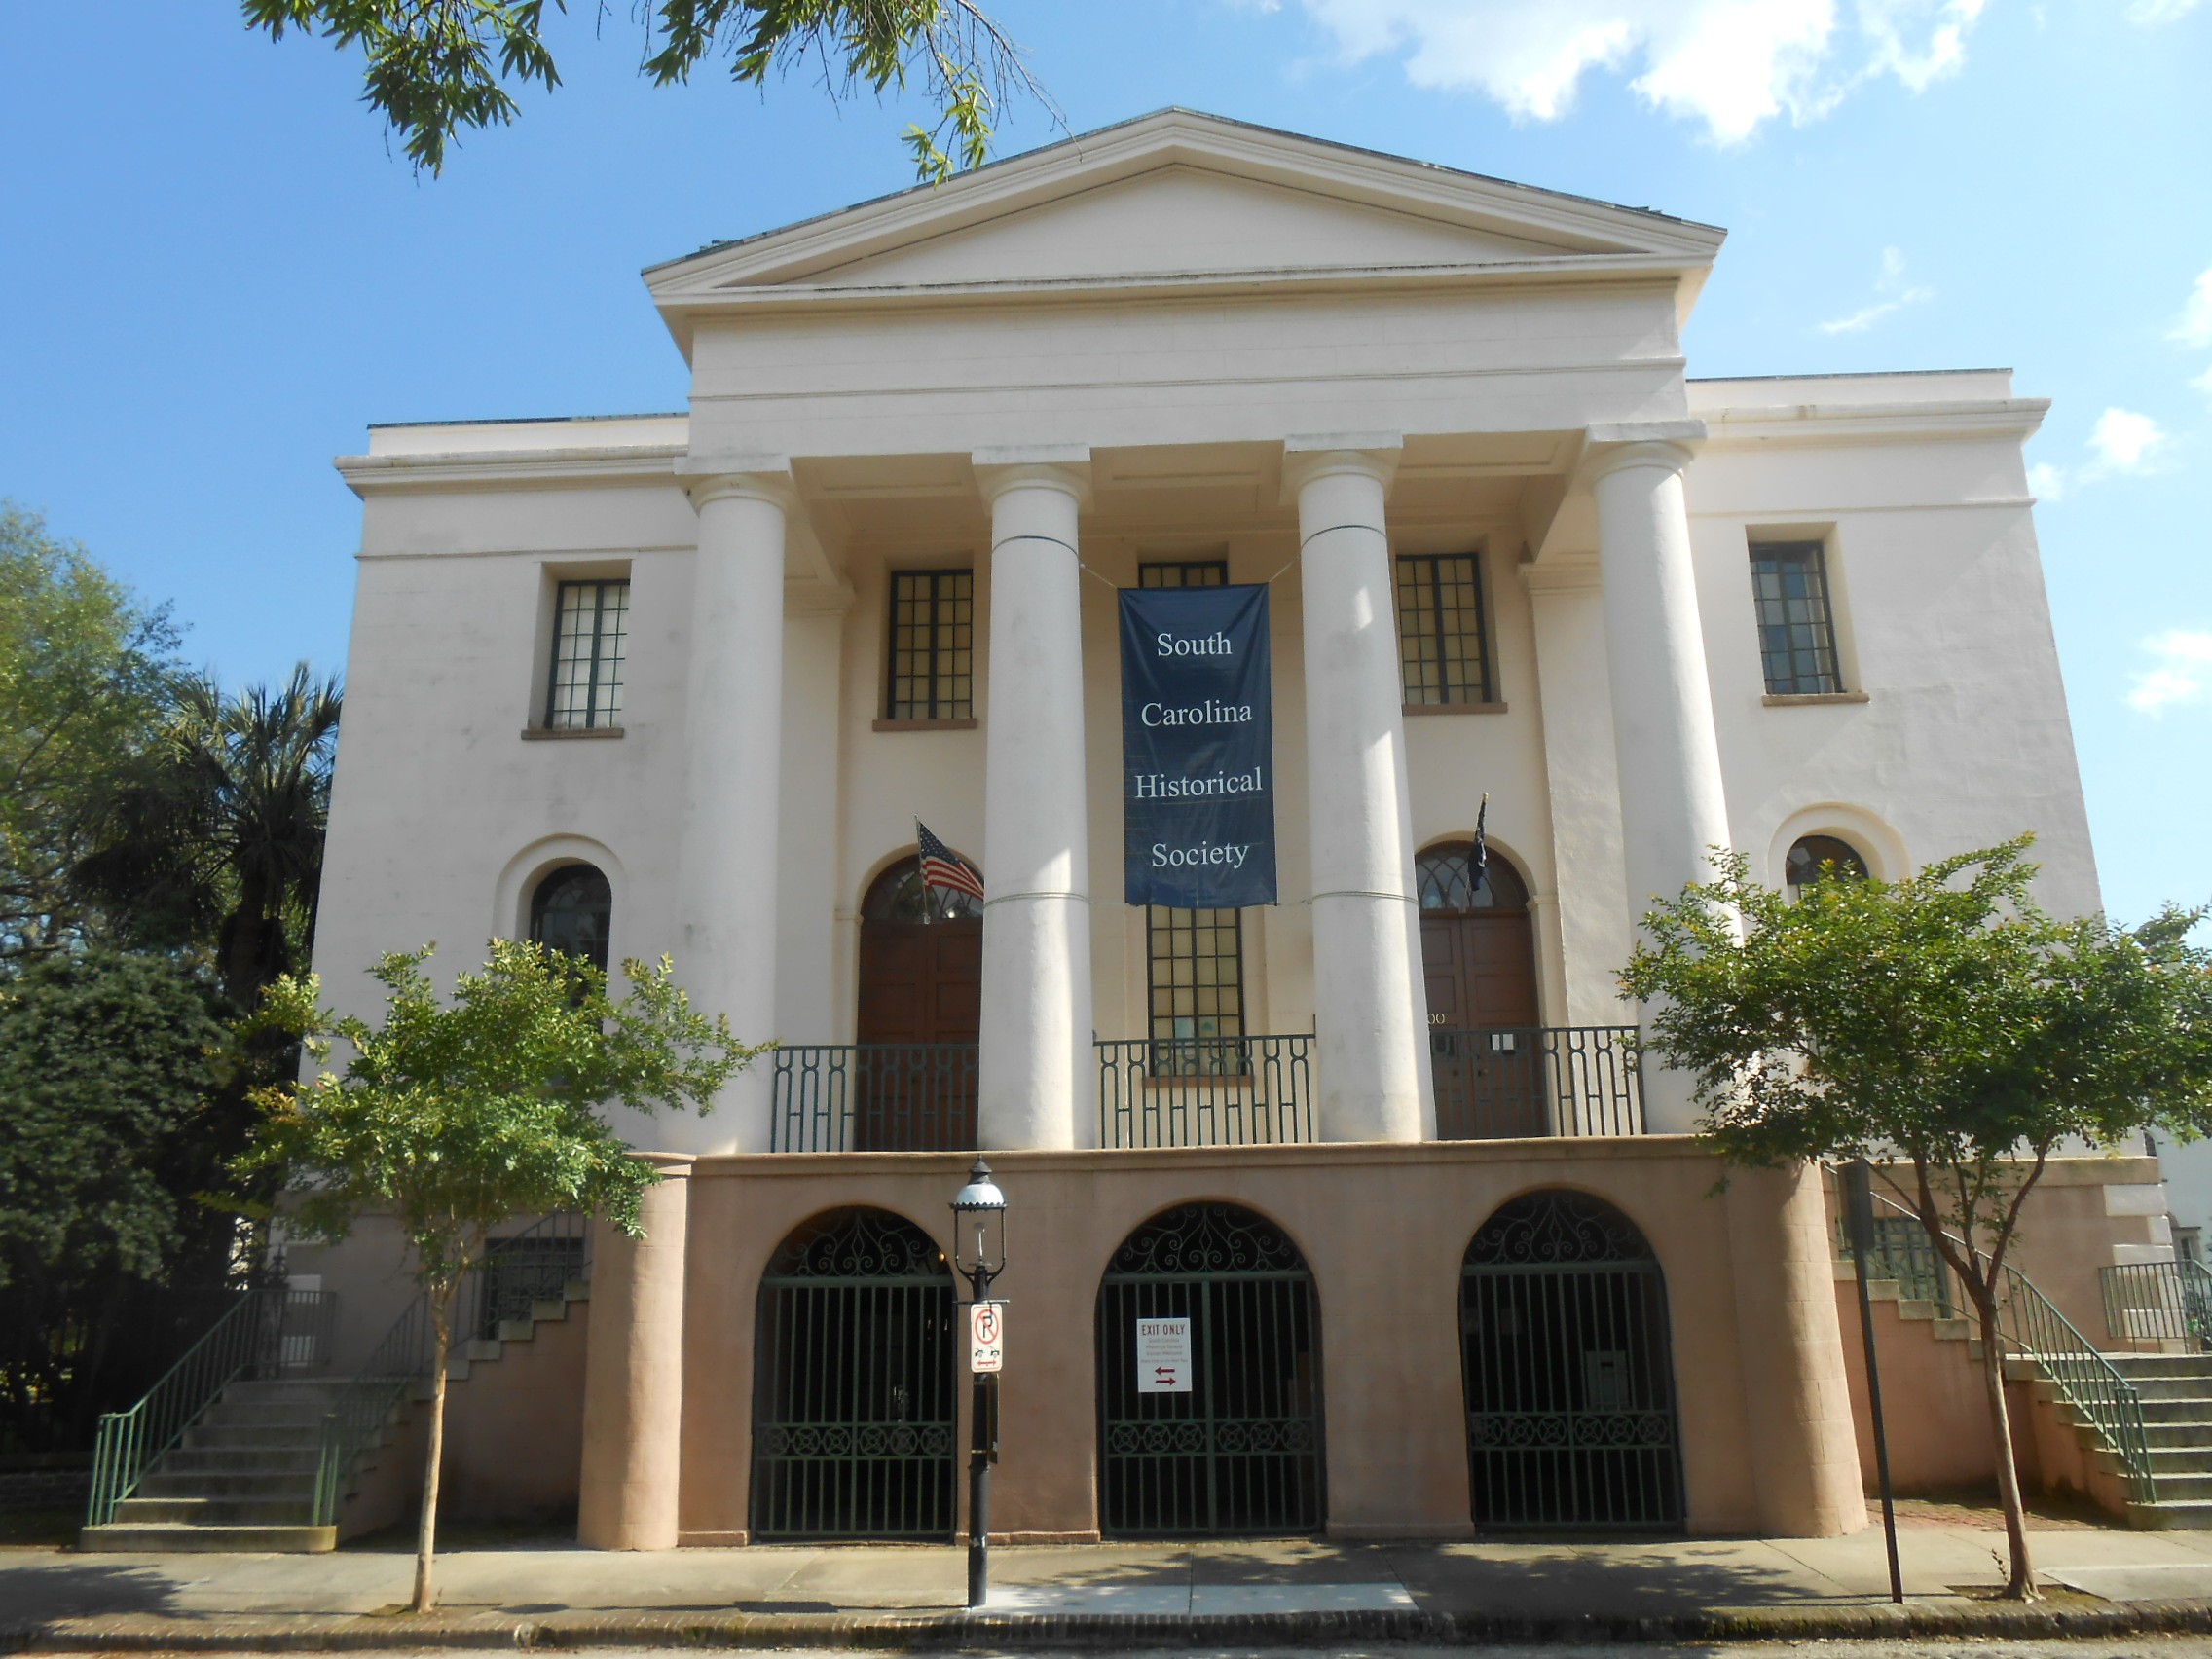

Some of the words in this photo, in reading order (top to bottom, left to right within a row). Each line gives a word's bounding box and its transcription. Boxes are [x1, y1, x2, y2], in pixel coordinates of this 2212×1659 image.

[1157, 632, 1233, 656] South
[1141, 700, 1252, 727] Carolina
[1134, 766, 1263, 797] Historical
[1152, 840, 1249, 868] Society
[1141, 1324, 1159, 1335] EXIT
[1162, 1324, 1185, 1335] ONLY
